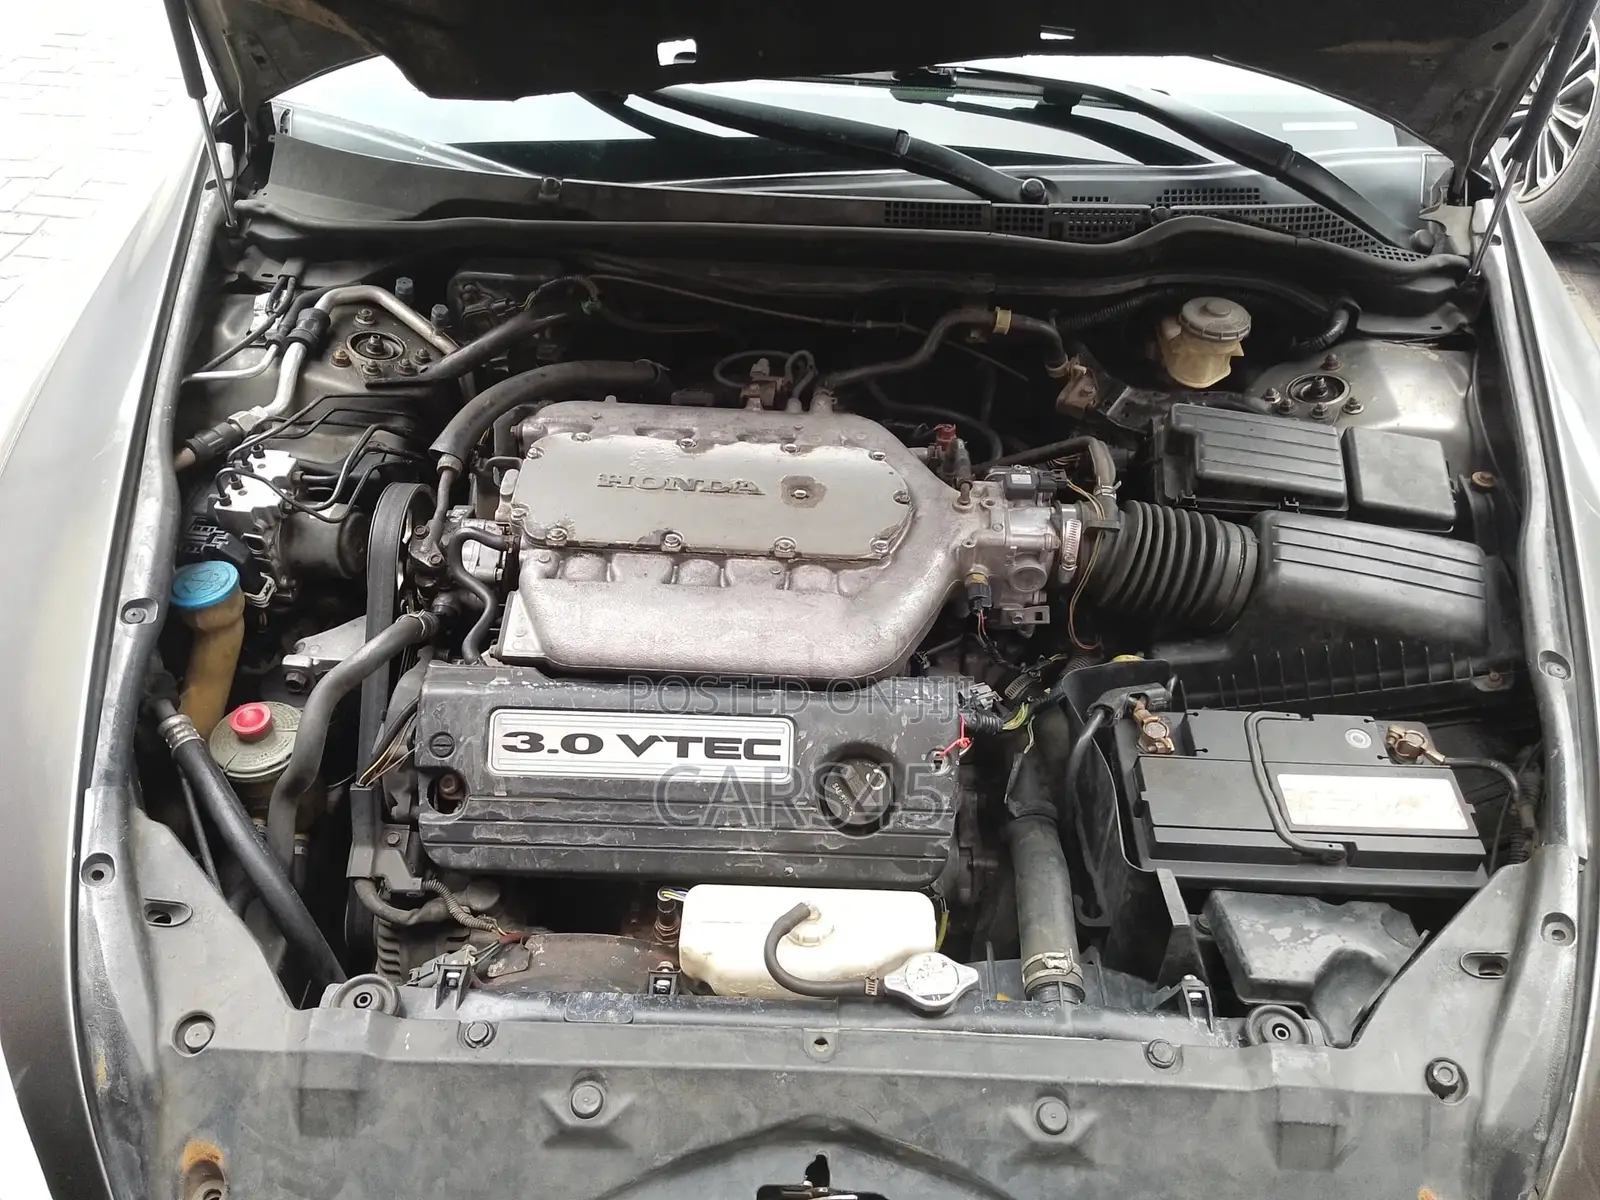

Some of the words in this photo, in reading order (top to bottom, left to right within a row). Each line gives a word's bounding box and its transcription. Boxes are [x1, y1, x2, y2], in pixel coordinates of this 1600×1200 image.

[597, 473, 766, 496] HONDA
[501, 731, 604, 755] 3.0
[616, 734, 781, 762] VTEC
